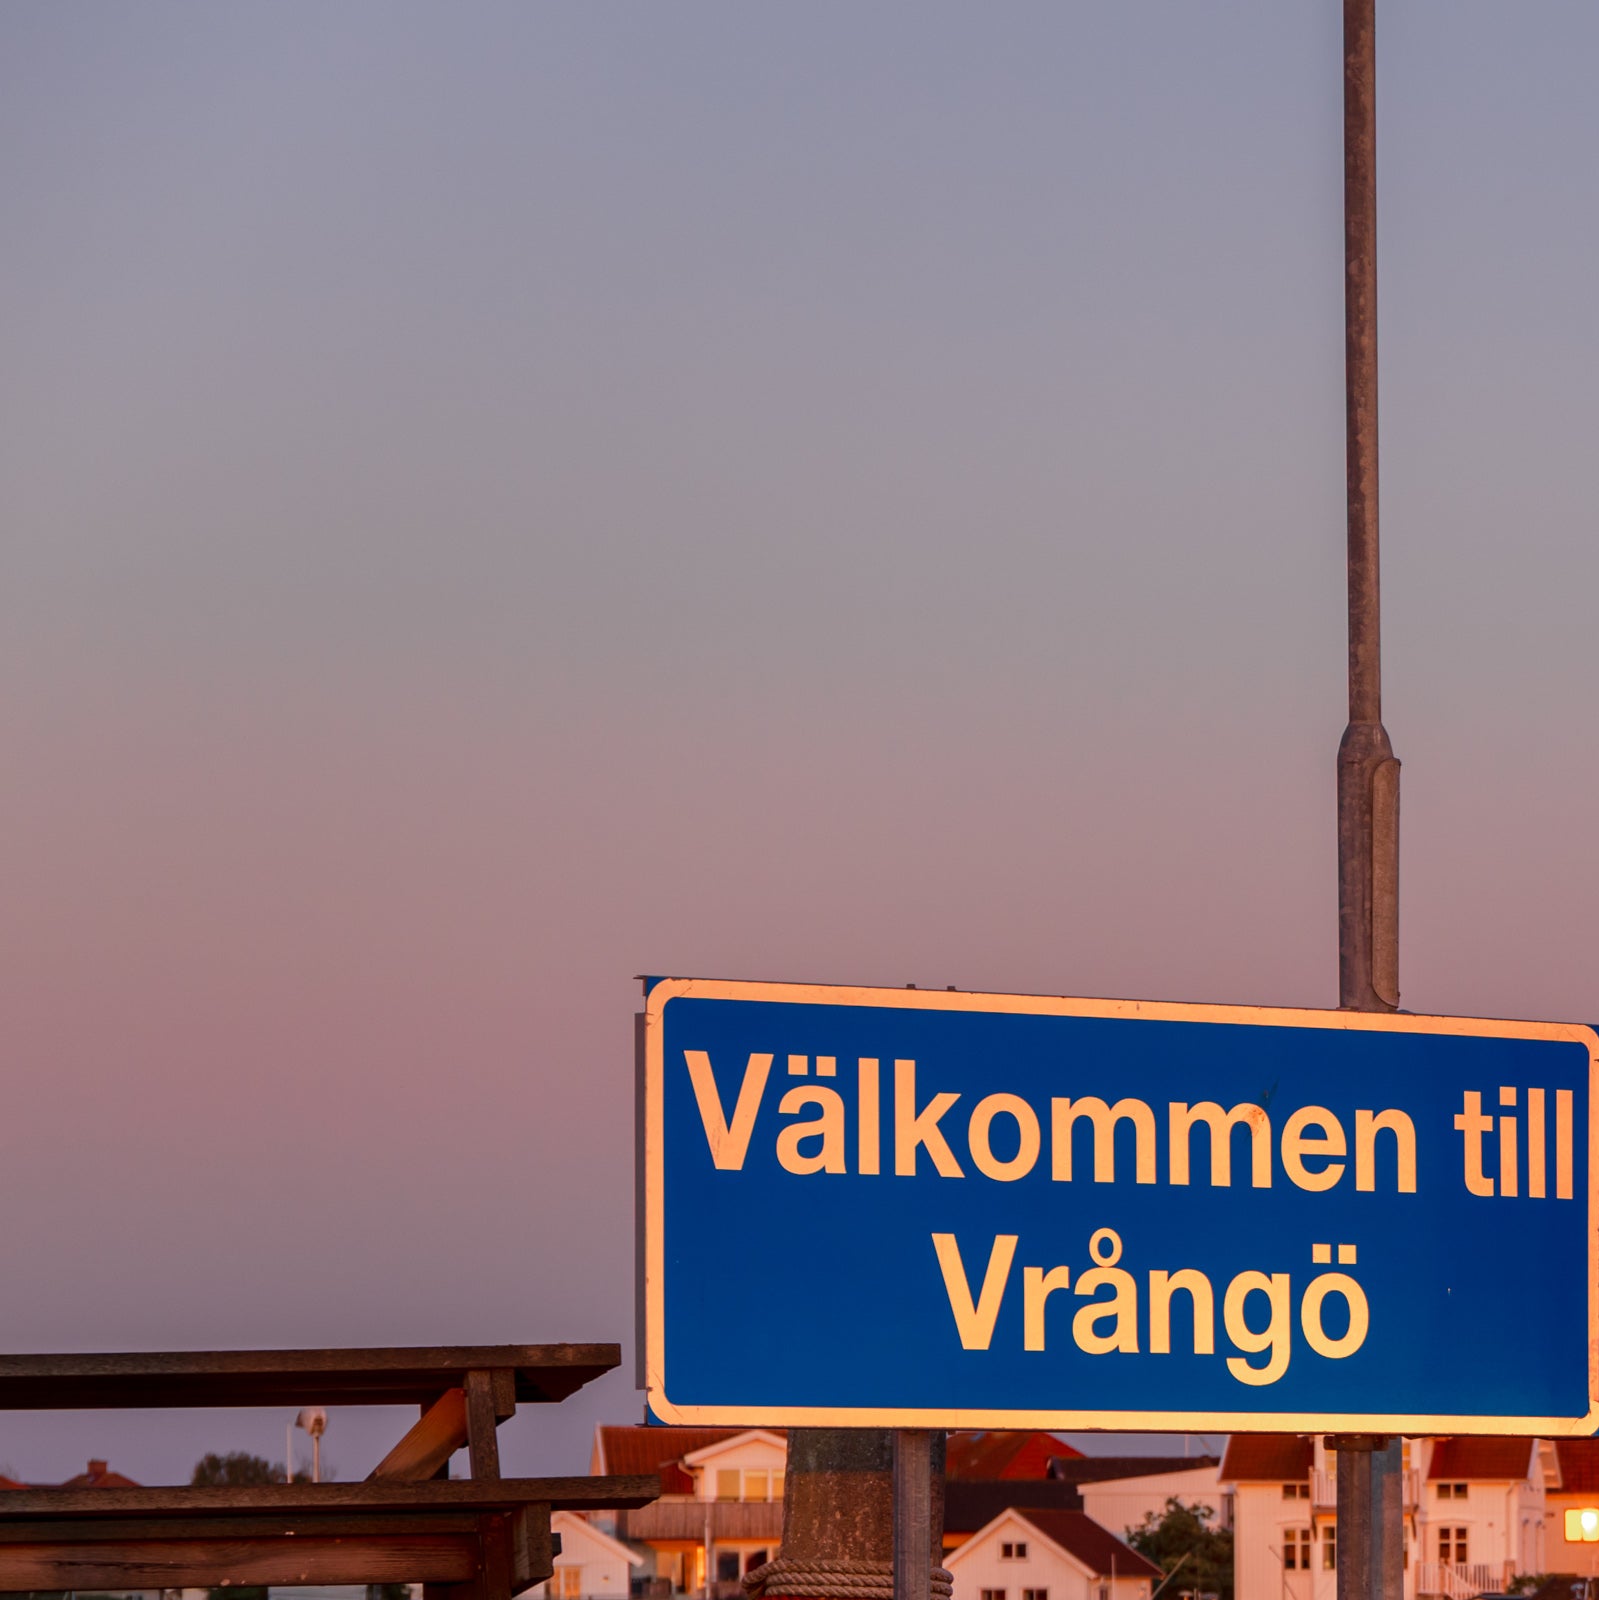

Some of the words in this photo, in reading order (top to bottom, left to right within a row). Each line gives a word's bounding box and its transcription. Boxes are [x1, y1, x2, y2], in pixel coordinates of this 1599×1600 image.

[684, 1050, 1417, 1194] Välkommen
[1454, 1087, 1574, 1200] till
[932, 1228, 1370, 1387] Vrångö
